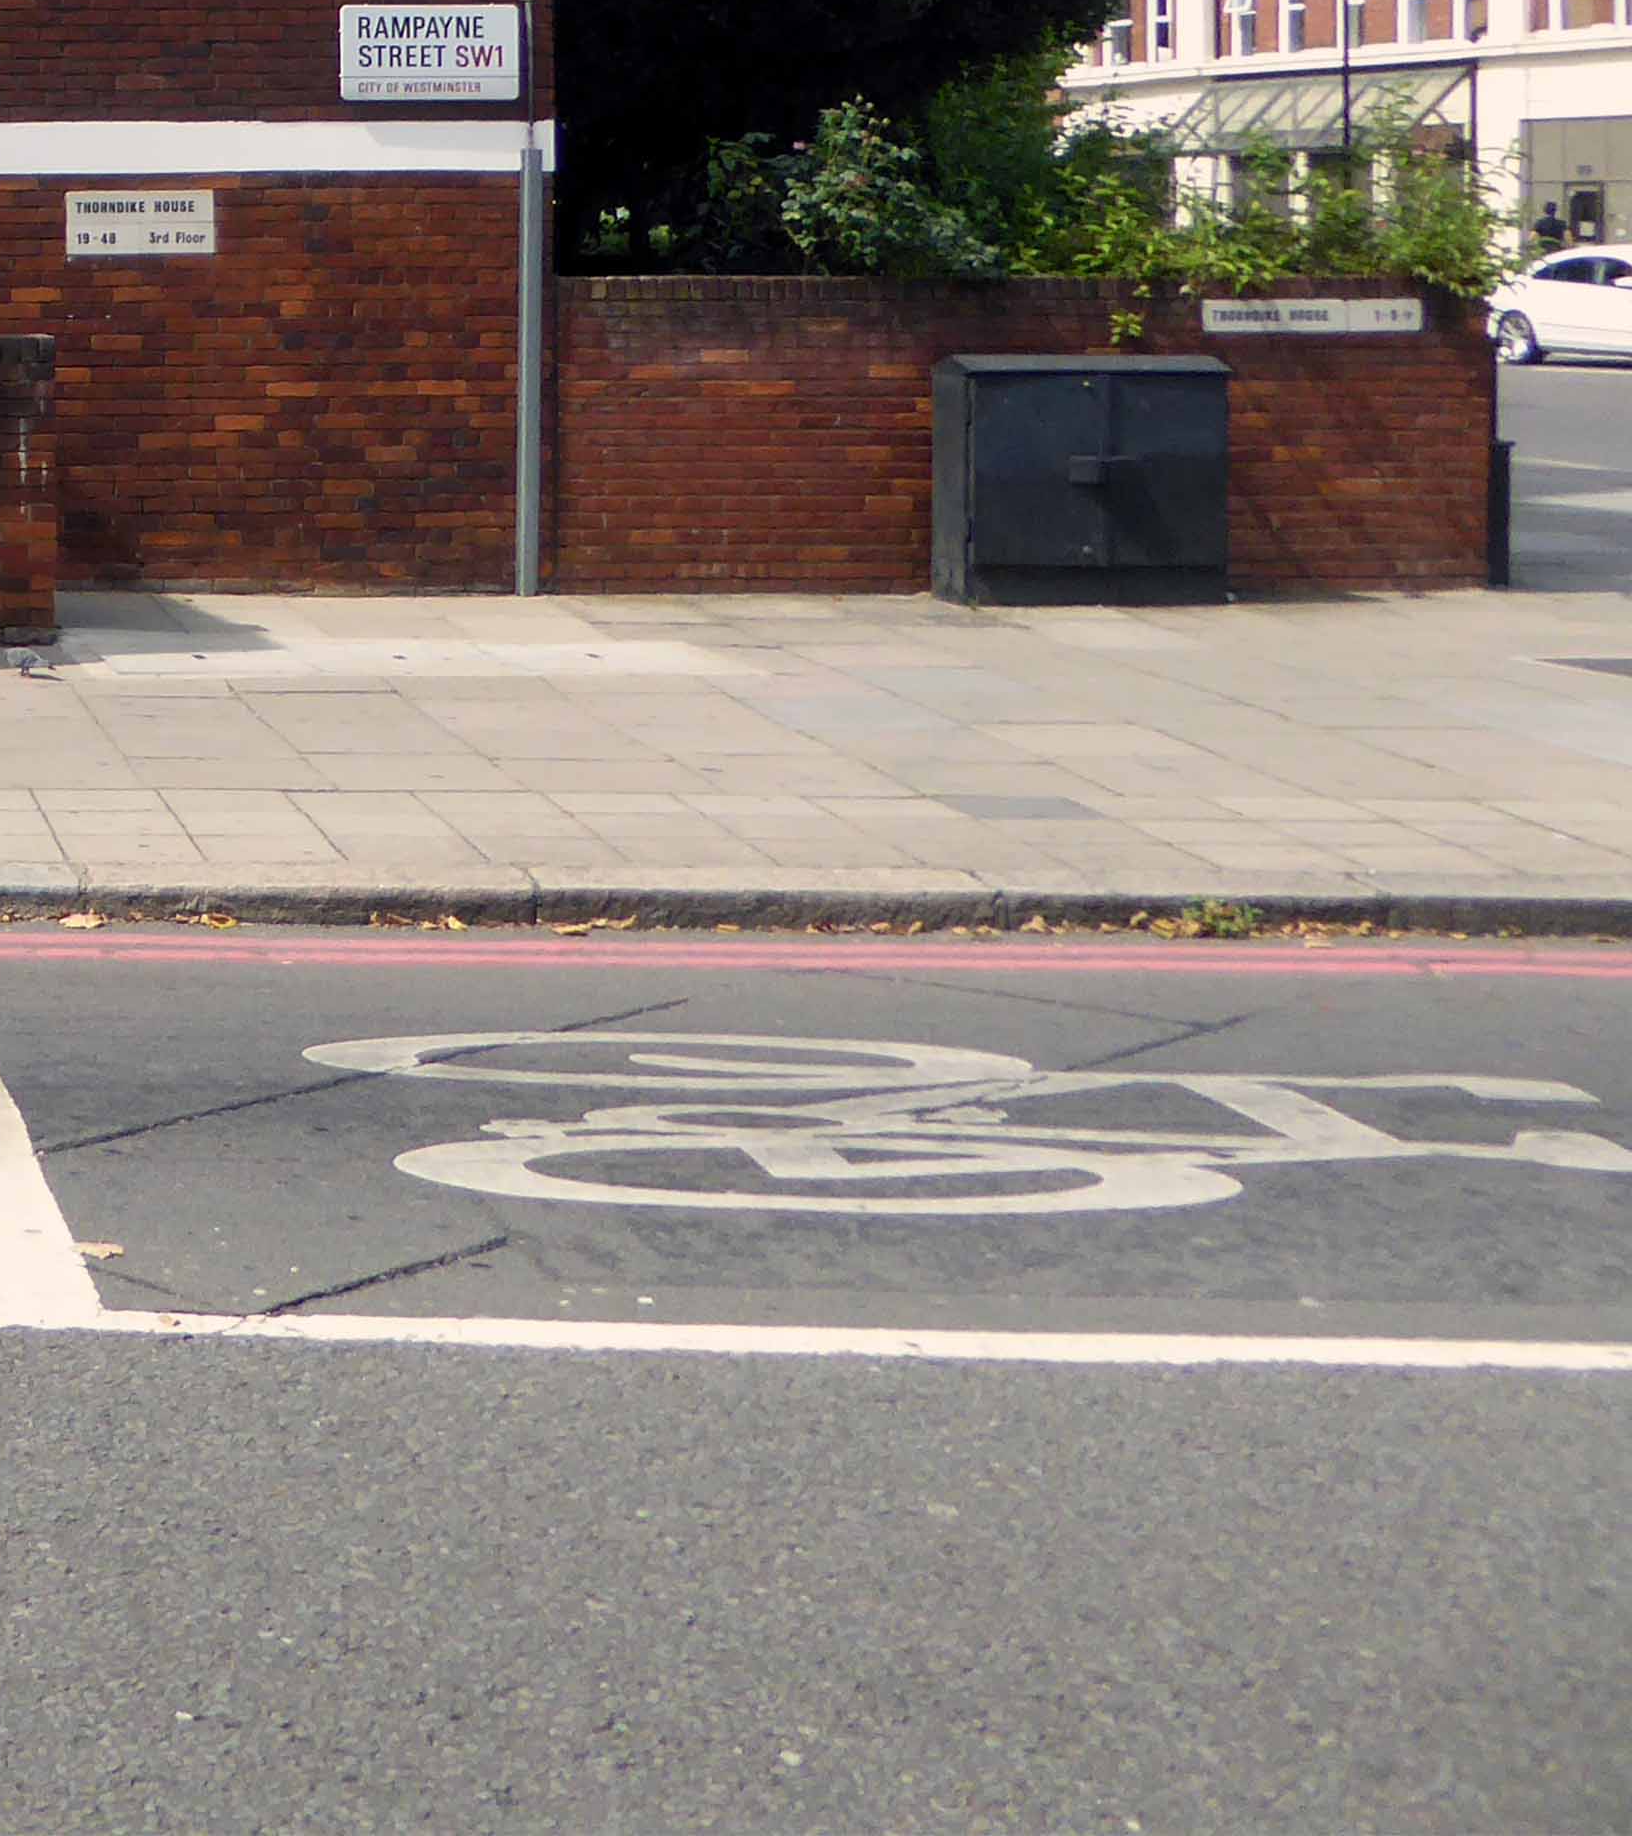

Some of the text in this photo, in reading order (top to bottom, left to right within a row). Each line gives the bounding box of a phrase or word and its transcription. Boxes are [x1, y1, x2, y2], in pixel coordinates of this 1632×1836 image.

[357, 16, 484, 39] RAMPAYNE
[358, 45, 504, 68] STREET SW1
[358, 82, 481, 93] CITY OF WESTMINSTER
[75, 200, 195, 214] THORNDIKE HOUSE
[148, 232, 206, 244] 3rd Floor
